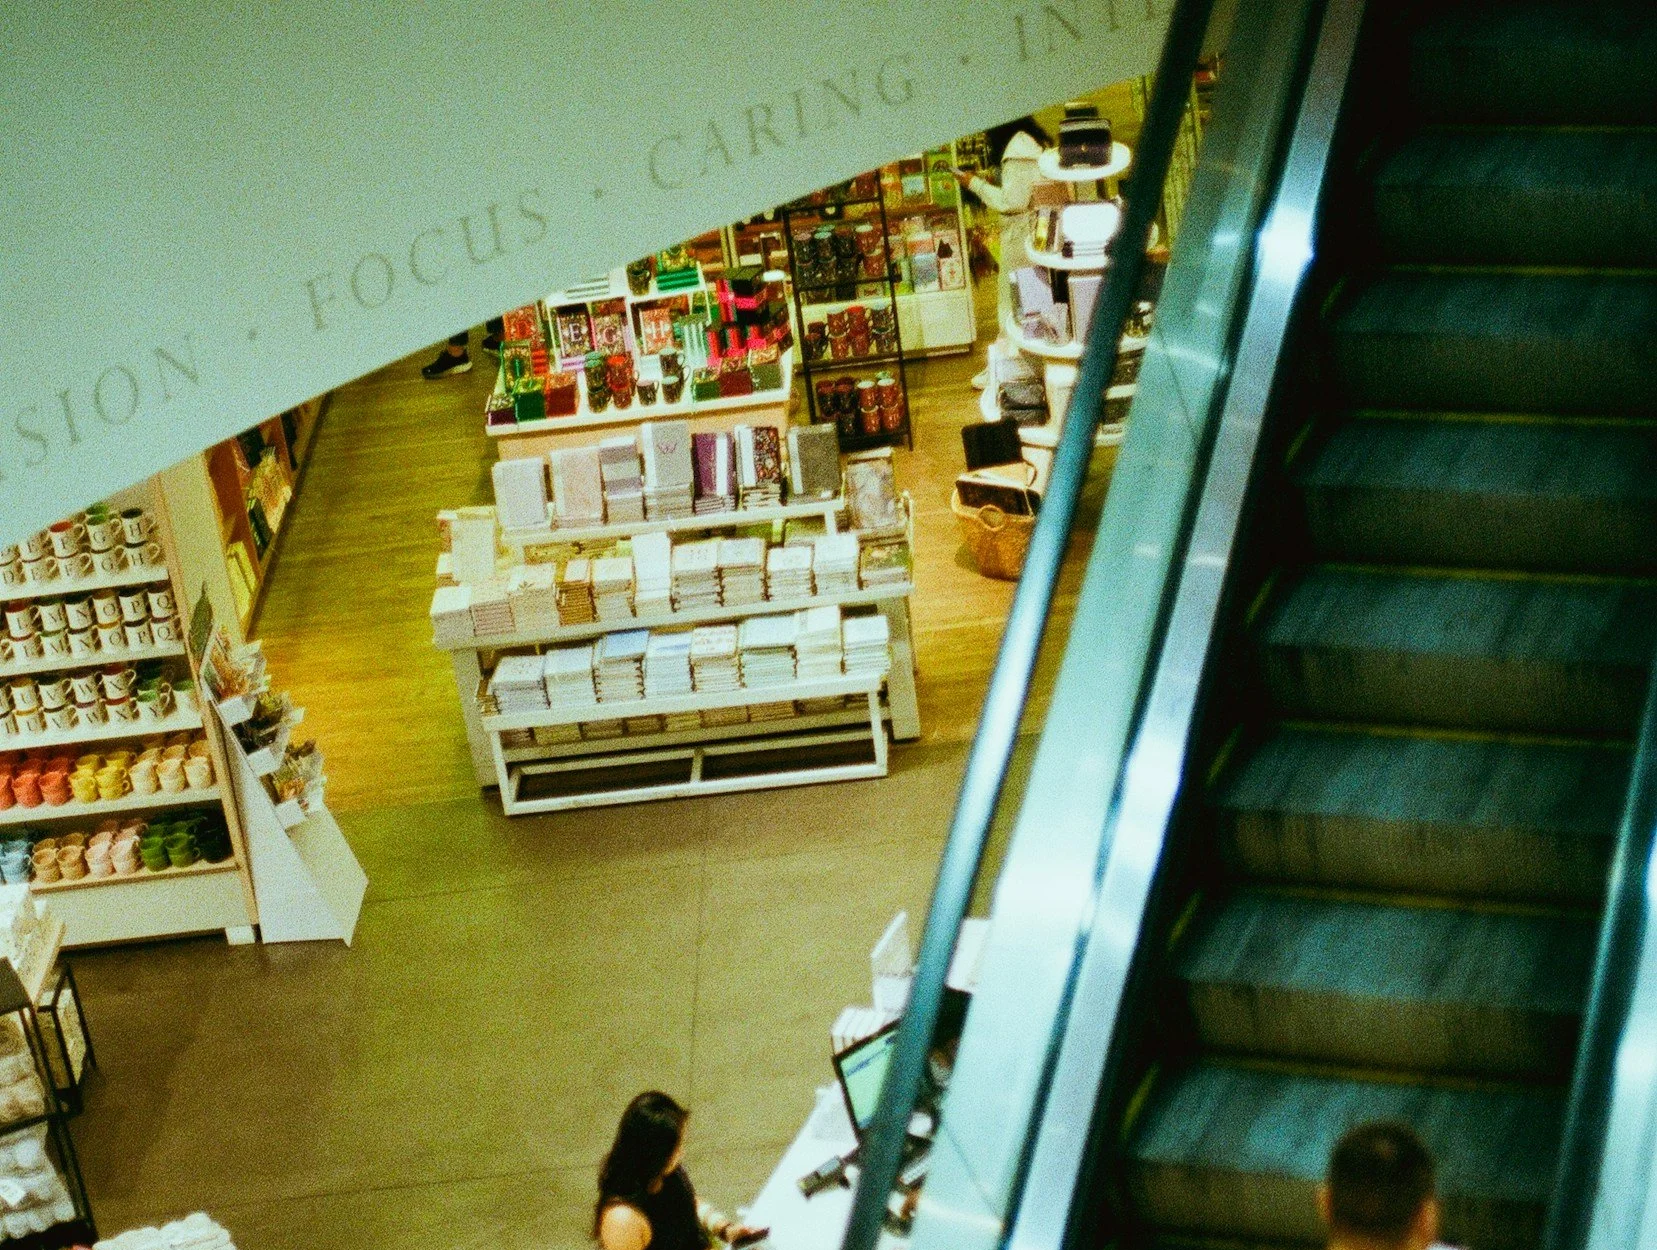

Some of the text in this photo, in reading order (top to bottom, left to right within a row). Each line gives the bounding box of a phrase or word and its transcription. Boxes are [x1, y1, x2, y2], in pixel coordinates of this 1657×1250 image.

[0, 333, 201, 482] SION
[304, 186, 548, 332] FOCUS
[647, 57, 915, 192] CARING
[92, 529, 107, 544] G
[129, 522, 142, 537] H
[101, 557, 114, 572] G
[131, 552, 145, 567] H
[102, 602, 116, 617] O
[130, 600, 142, 615] P
[156, 593, 173, 611] Q
[138, 630, 149, 645] P
[157, 626, 174, 642] Q
